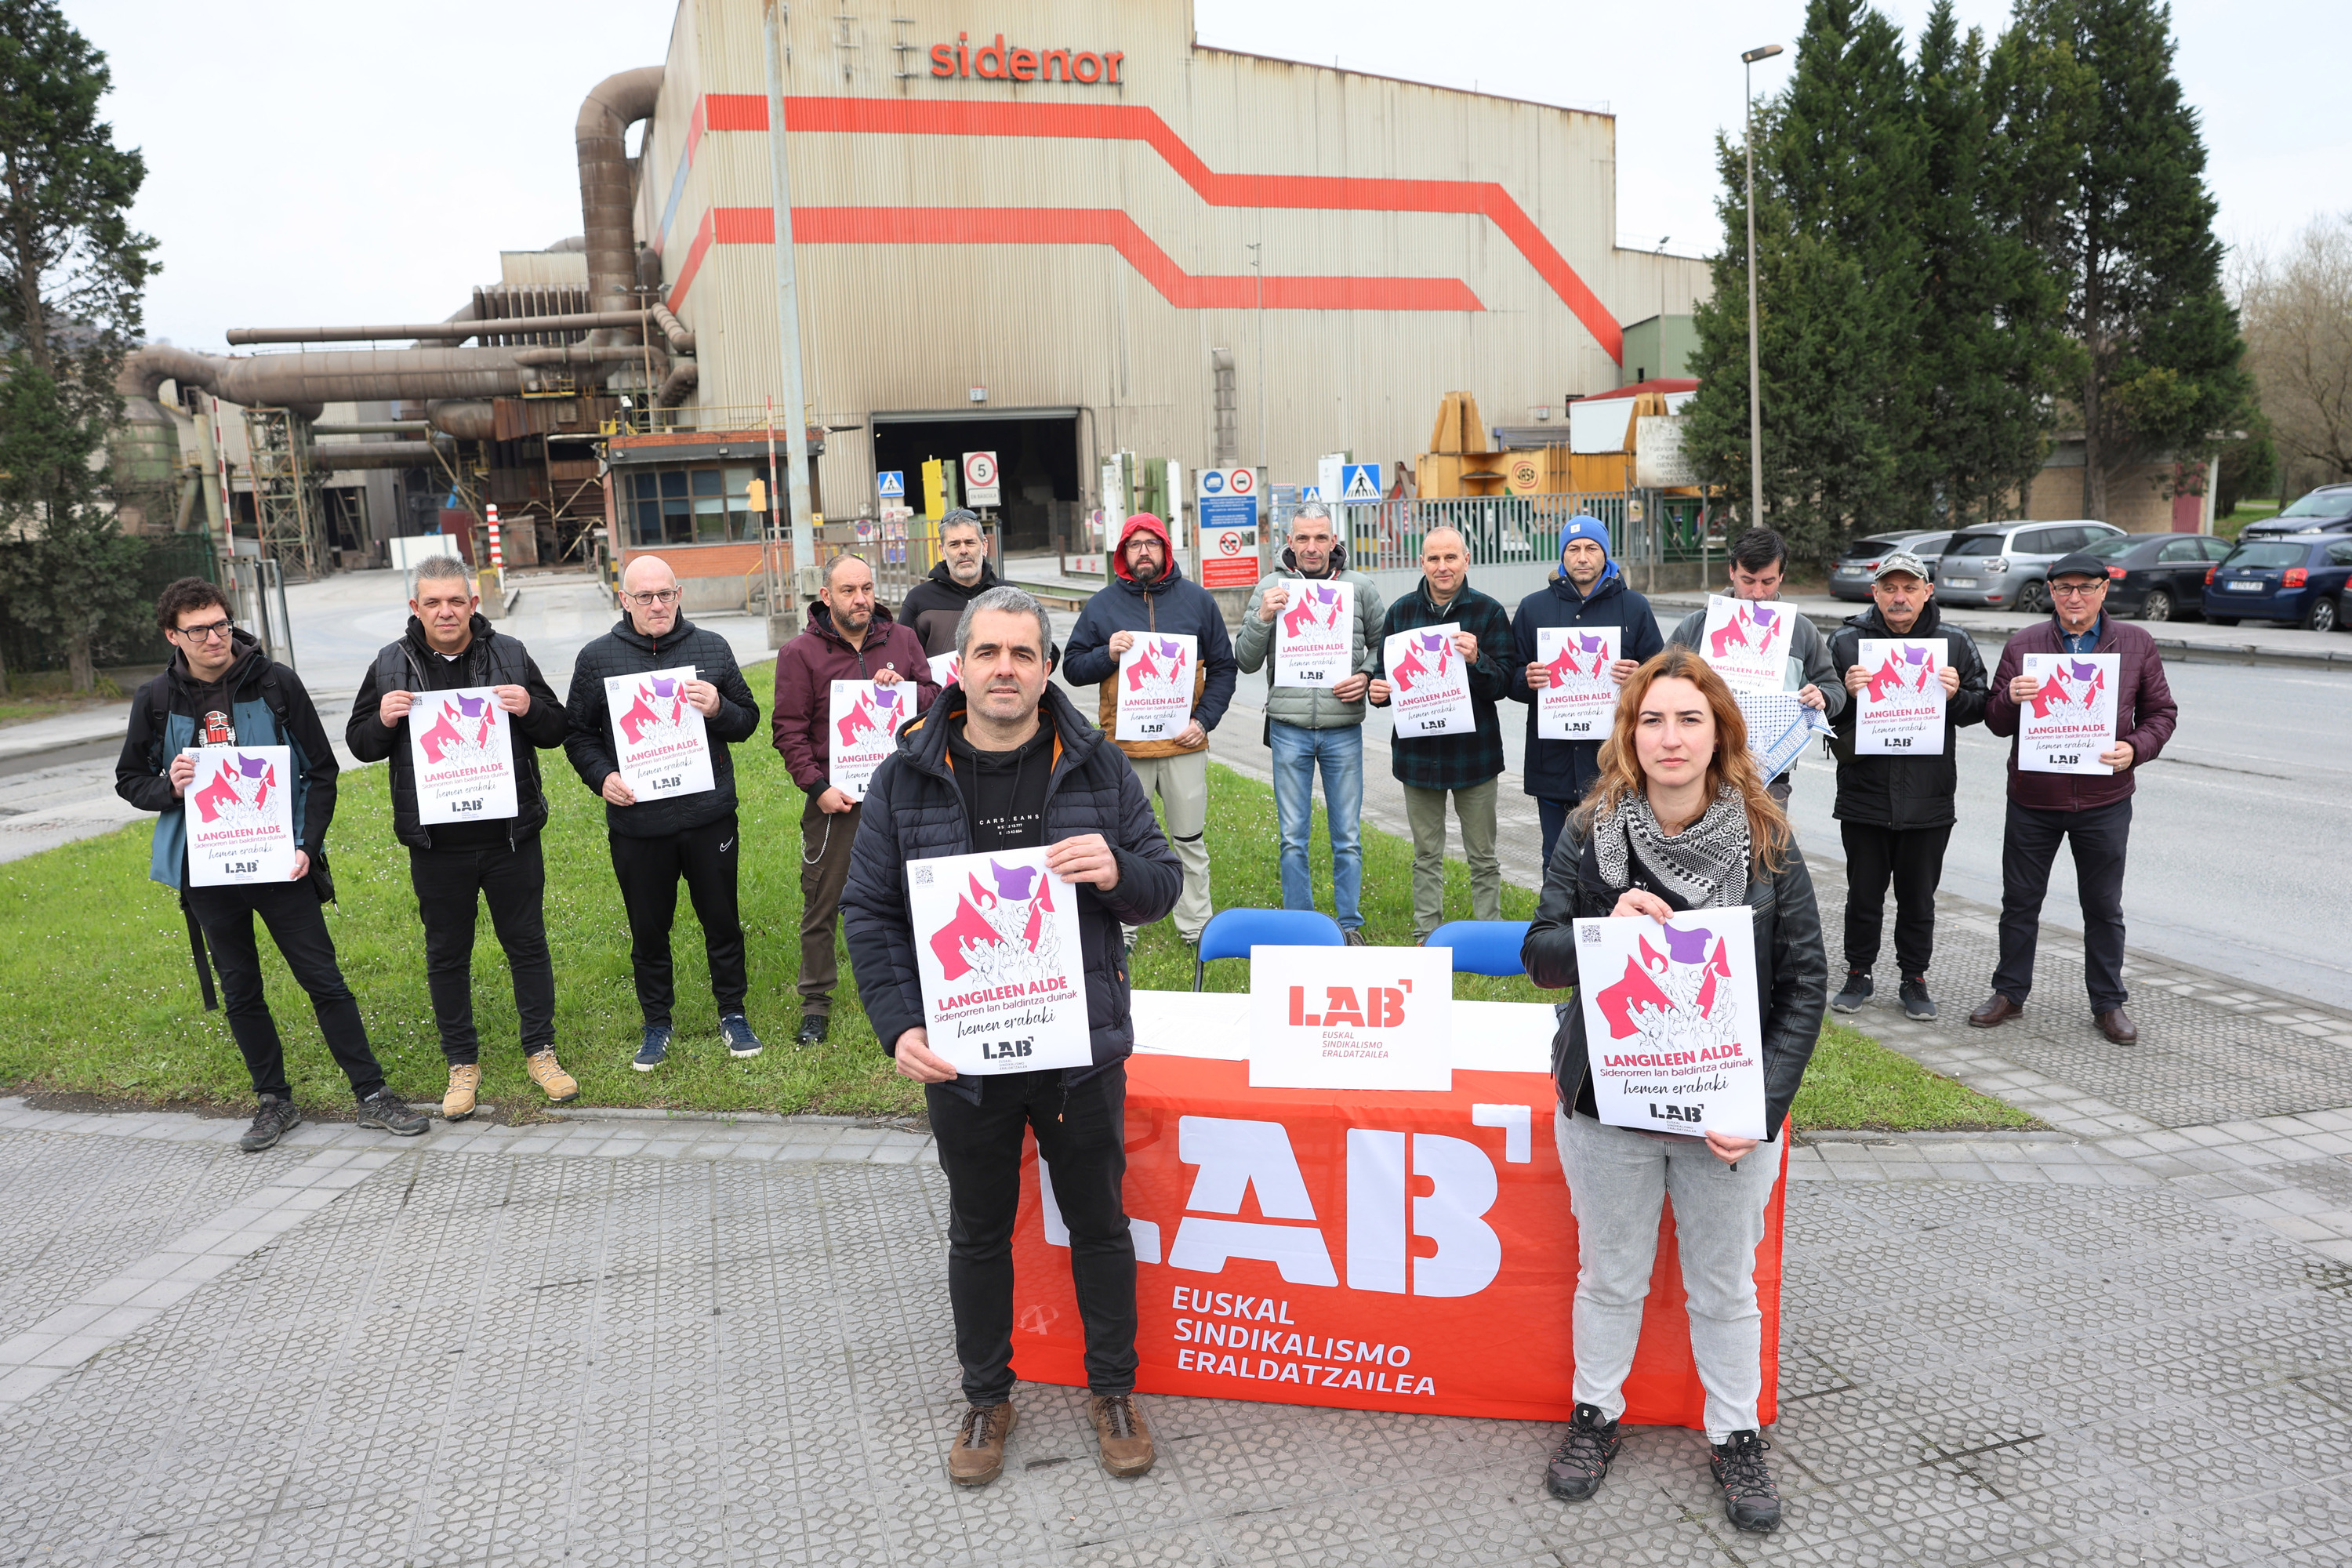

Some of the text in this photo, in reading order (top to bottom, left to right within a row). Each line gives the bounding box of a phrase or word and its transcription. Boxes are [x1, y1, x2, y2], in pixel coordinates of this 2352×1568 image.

[931, 31, 1124, 83] sidenor
[978, 464, 985, 477] 5
[1283, 644, 1323, 653] LANGILEEN
[1289, 659, 1310, 667] hemen
[1710, 664, 1752, 673] ANGILEEN
[1301, 670, 1325, 680] LAB
[1398, 688, 1461, 706] LANGILEEN ALDE
[1545, 694, 1589, 704] LANGILEEN
[1131, 712, 1152, 721] hemen
[1408, 711, 1428, 720] hemen
[1553, 710, 1575, 719] hemen
[1864, 709, 1911, 719] LANGILEEN
[1142, 723, 1165, 732] LAB
[1421, 718, 1446, 730] LAB
[1565, 721, 1592, 731] LAB
[1871, 725, 1896, 735] hemen
[2028, 725, 2079, 735] LANGILEEN
[1885, 737, 1913, 746] LAB
[2036, 741, 2062, 750] hemen
[626, 739, 699, 763] LANGILEEN ALDE
[837, 753, 884, 763] LANGILEEN
[2049, 753, 2081, 764] LAB
[425, 763, 503, 782] LANGILEEN ALDE
[638, 767, 662, 779] hemen
[845, 770, 869, 779] hemen
[652, 774, 681, 789] LAB
[436, 788, 463, 799] hemen
[452, 798, 484, 812] LAB
[198, 826, 281, 841] LANGILEEN ALDE
[209, 849, 237, 859] hemen
[225, 860, 259, 873] LAB
[938, 975, 1068, 1011] LANGILEEN ALDE
[935, 989, 1077, 1024] Sidenorren lan baldintza duinak
[1289, 979, 1412, 1028] LAB
[957, 1007, 1057, 1039] hemen erabaki
[1323, 1031, 1355, 1040] EUSKAL
[982, 1036, 1034, 1059] LAB
[1323, 1040, 1383, 1049] SINDIKALISMO
[1322, 1050, 1389, 1058] ERALDATZAILEA
[1603, 1043, 1743, 1066] LANGILEEN ALDE
[1599, 1058, 1754, 1077] Sidenorren lan baldintza duinak
[1624, 1073, 1730, 1095] hemen erabaki
[1650, 1103, 1704, 1123] LAB
[1172, 1287, 1294, 1325] EUSKAL
[1174, 1319, 1411, 1368] SINDIKALISMO
[1178, 1348, 1436, 1396] ERALDATZAILEA
